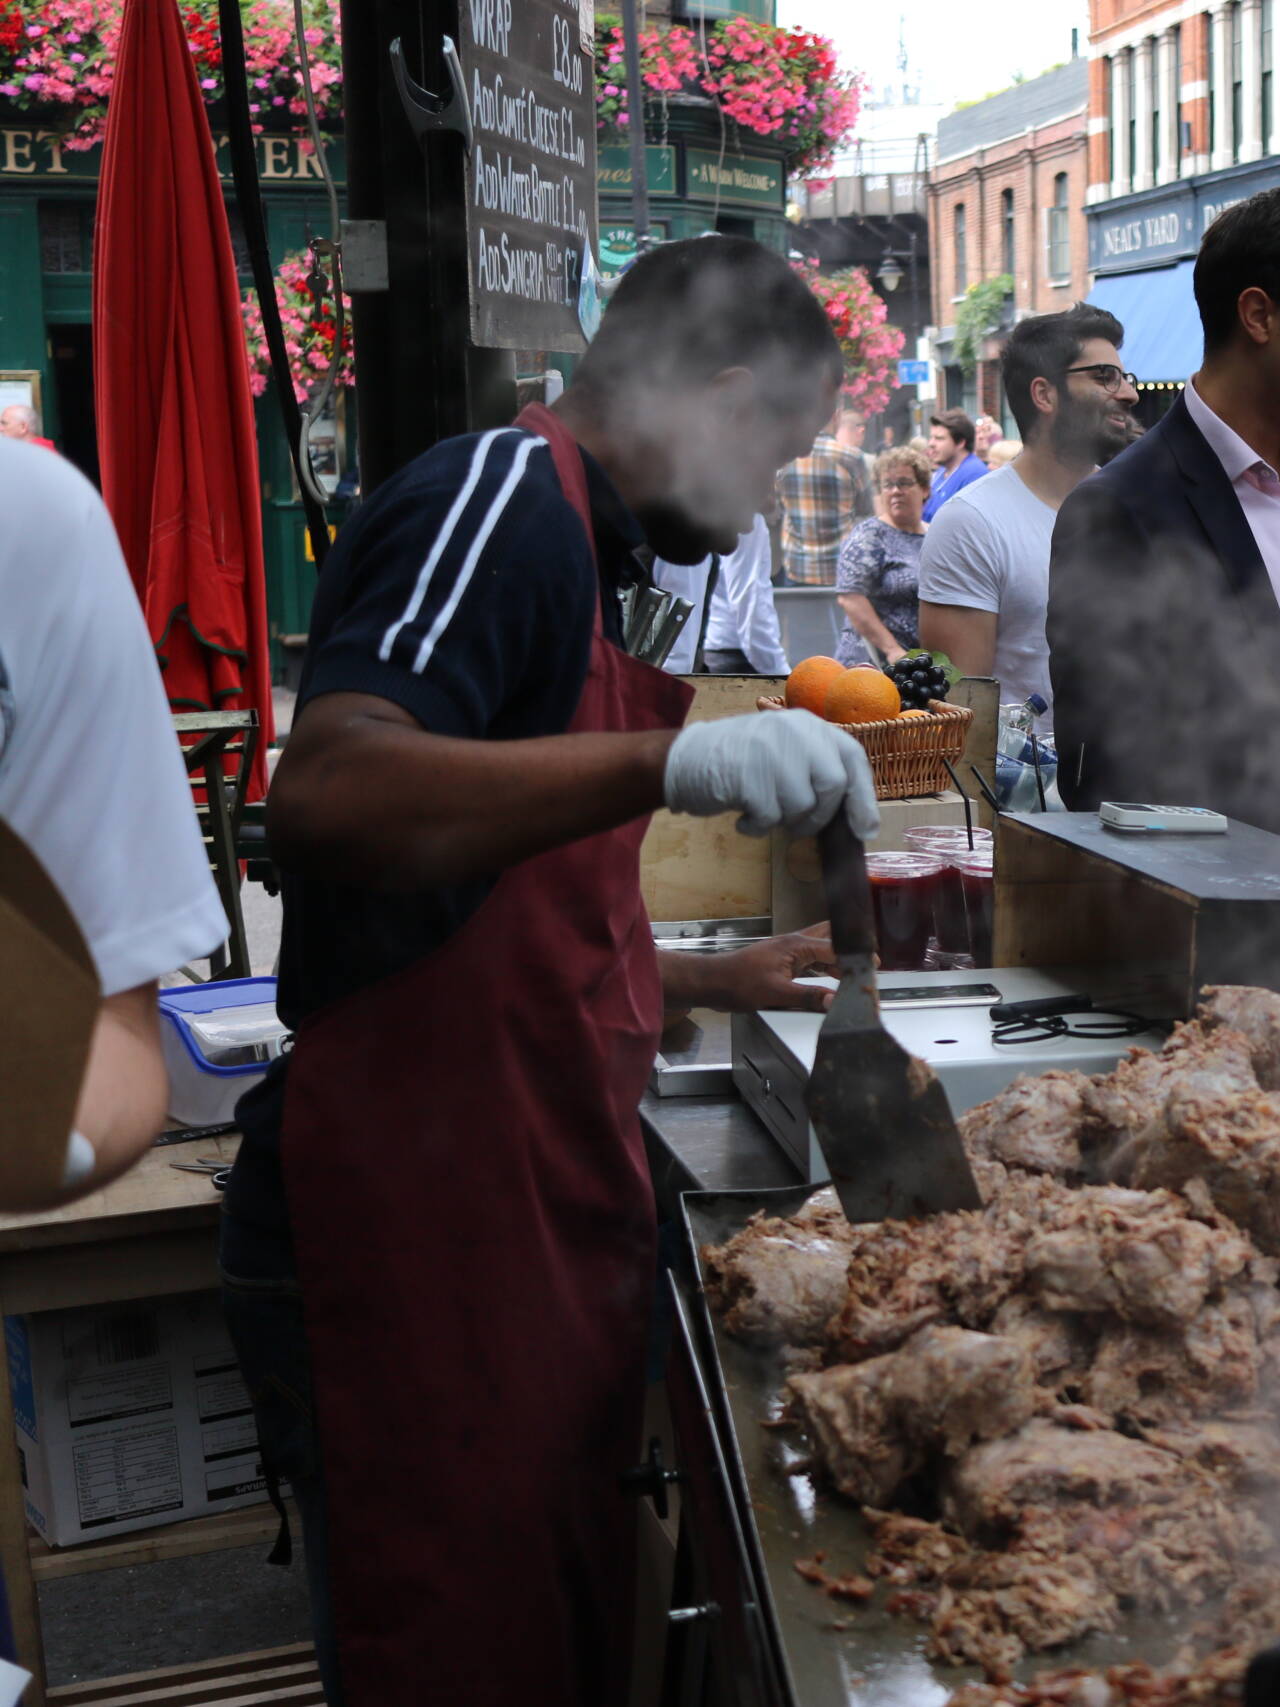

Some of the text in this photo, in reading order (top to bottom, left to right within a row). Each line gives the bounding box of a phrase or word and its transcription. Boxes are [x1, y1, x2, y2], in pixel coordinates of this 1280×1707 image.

[469, 0, 583, 95] WRAP £8.00
[528, 90, 559, 157] CHEESE
[561, 106, 586, 168] £1.00
[496, 152, 532, 220] WATER
[532, 163, 561, 228] BOTTLE
[608, 230, 634, 243] THE
[1143, 212, 1180, 247] YARD
[501, 232, 546, 302] SANGRIA
